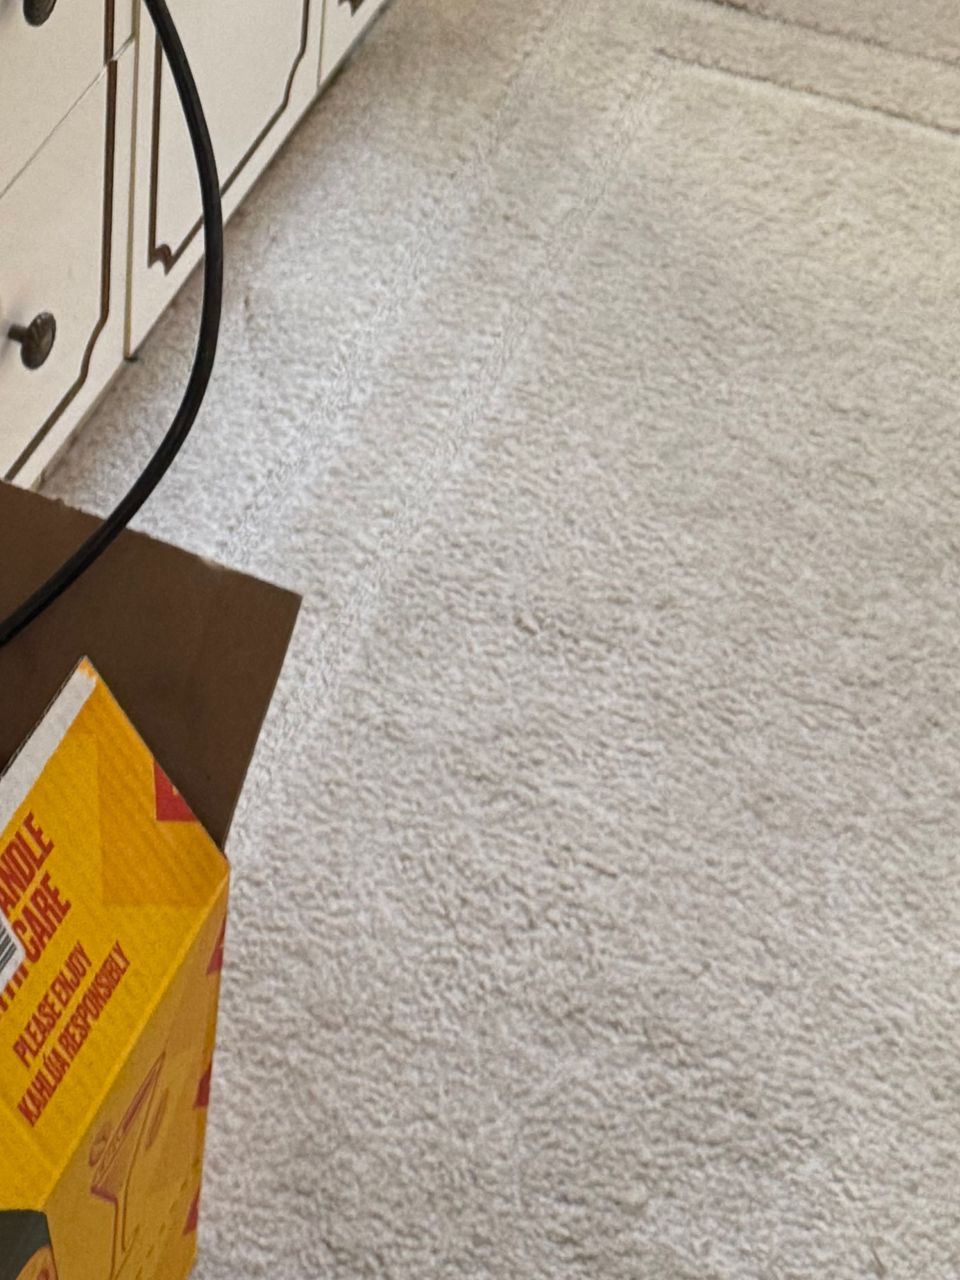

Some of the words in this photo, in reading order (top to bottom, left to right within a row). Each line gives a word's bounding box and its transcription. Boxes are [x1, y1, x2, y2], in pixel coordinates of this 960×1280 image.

[11, 870, 73, 964] CARE
[12, 992, 63, 1069] PLEASE
[49, 939, 93, 1009] ENJOY
[17, 1045, 71, 1128] KAHLÚA
[57, 938, 131, 1061] RESPONSIBLY
